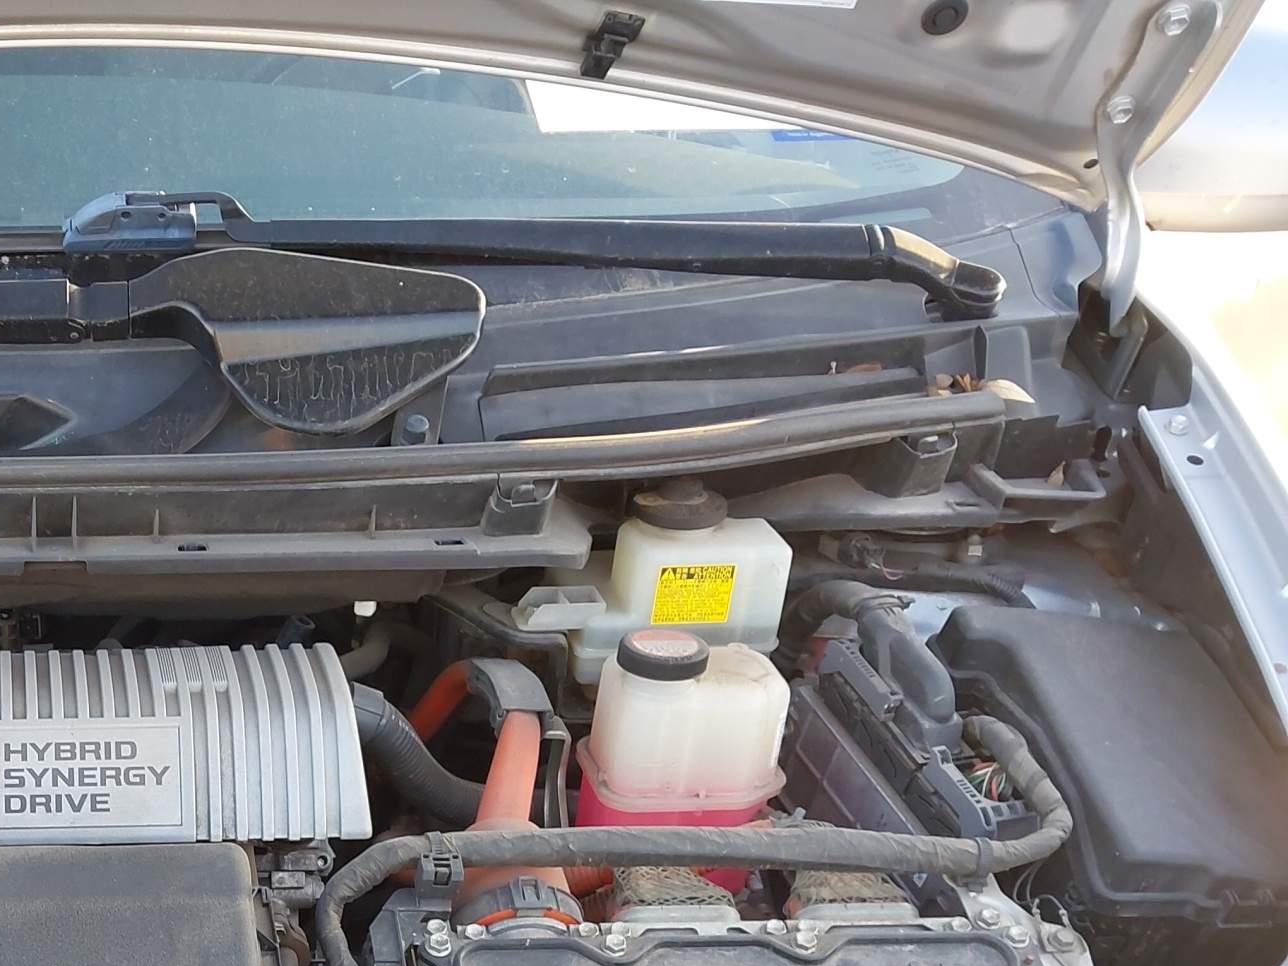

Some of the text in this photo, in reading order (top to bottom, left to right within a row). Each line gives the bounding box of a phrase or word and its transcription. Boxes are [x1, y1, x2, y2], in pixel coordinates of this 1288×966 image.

[3, 741, 138, 762] HYBRID
[3, 766, 171, 788] SYNERGY
[4, 793, 111, 814] DRIVE
